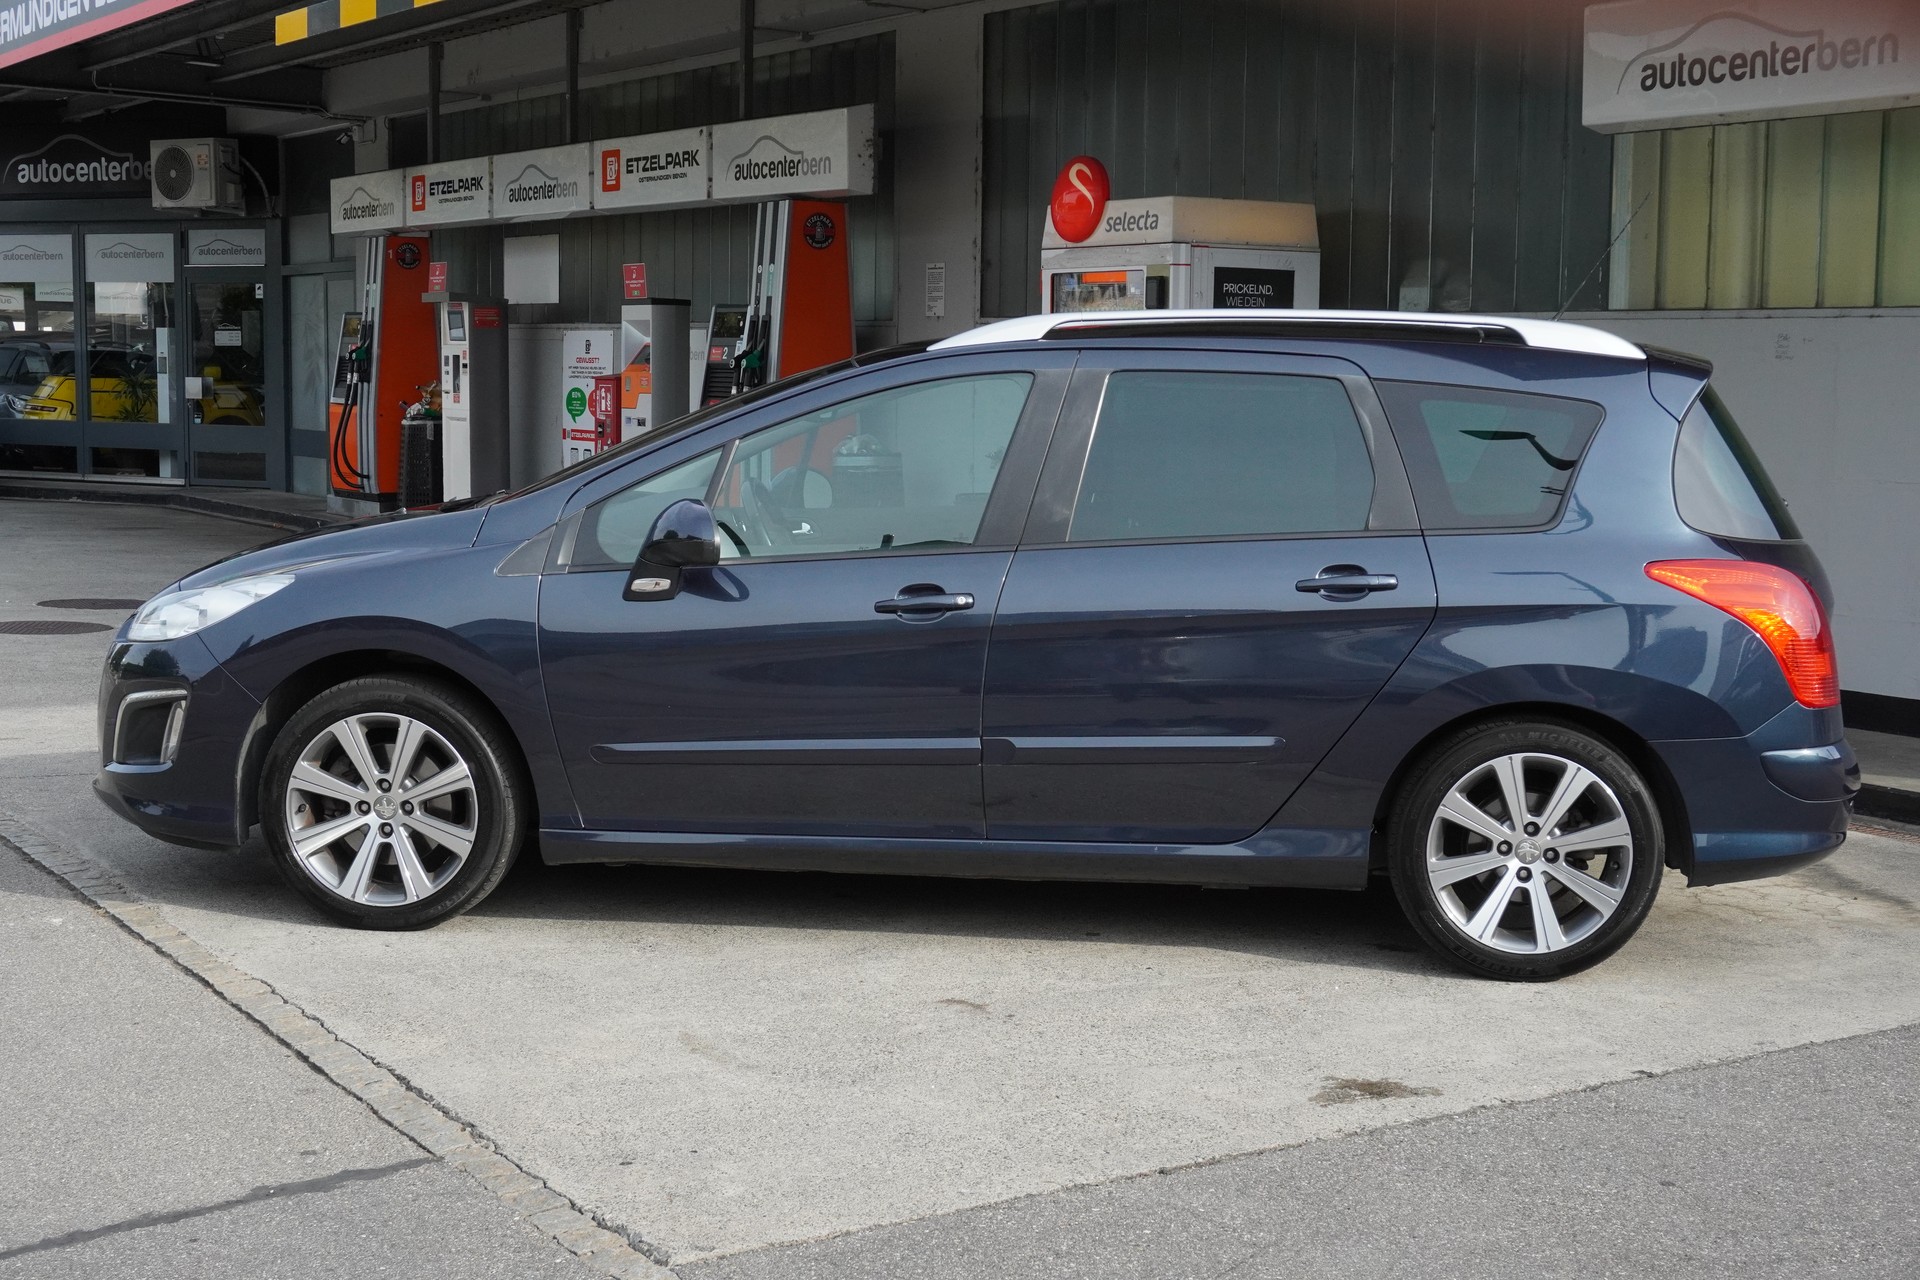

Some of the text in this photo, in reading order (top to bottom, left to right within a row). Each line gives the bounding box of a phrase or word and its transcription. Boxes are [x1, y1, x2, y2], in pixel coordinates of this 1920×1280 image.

[1640, 31, 1898, 92] autocenterbern
[17, 155, 151, 184] autocenterbe
[625, 149, 700, 174] ETZELPARK
[734, 152, 832, 181] autocenterbern
[429, 176, 484, 197] ETZELPARK
[508, 178, 578, 203] autocenterbern
[342, 199, 395, 221] autocenterbern
[1104, 210, 1159, 233] selecta
[2, 251, 64, 261] autocenterbern
[100, 249, 164, 259] autocenterbern
[198, 246, 262, 256] autocenterbern
[1223, 283, 1274, 296] PRICKELND,
[1226, 296, 1266, 308] WIE DEIN
[722, 346, 728, 360] 2
